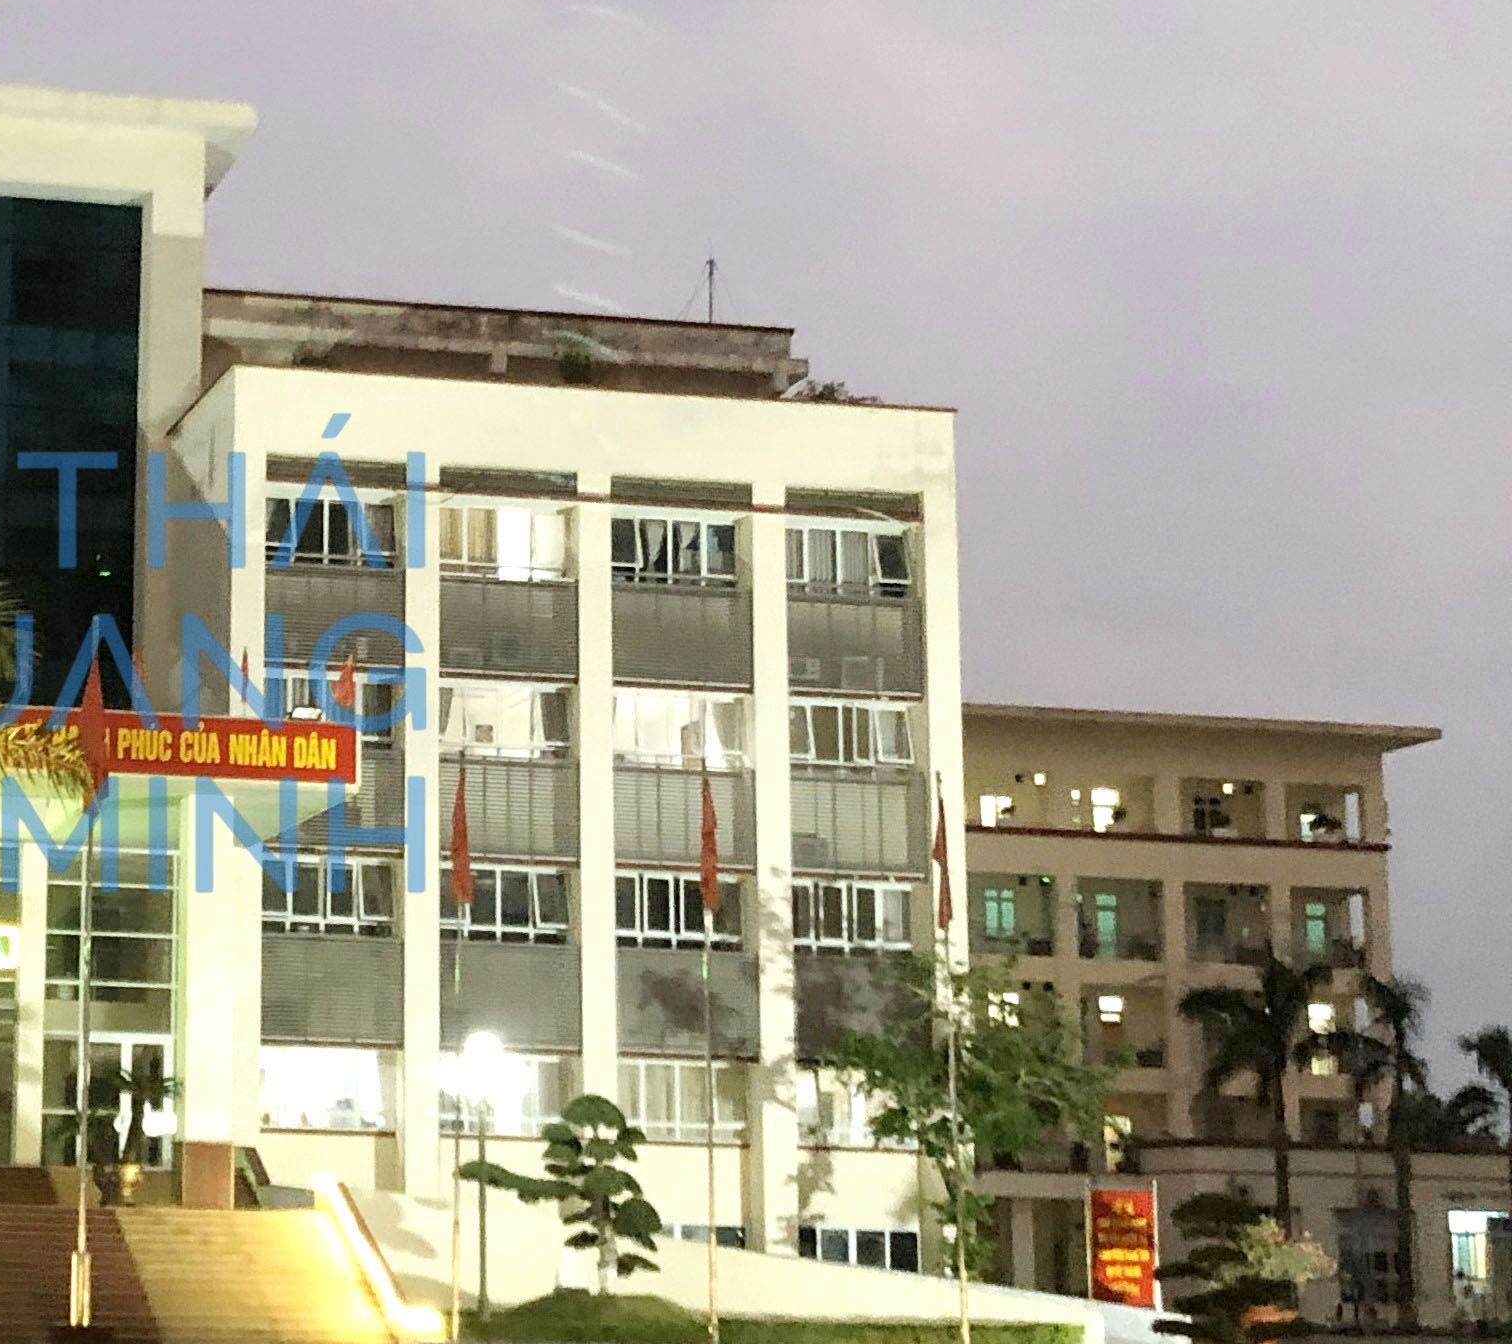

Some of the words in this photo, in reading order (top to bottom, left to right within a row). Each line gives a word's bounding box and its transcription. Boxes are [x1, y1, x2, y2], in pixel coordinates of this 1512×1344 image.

[179, 721, 221, 764] CỦA
[228, 728, 287, 769] NHÂN
[292, 731, 337, 771] DÂN
